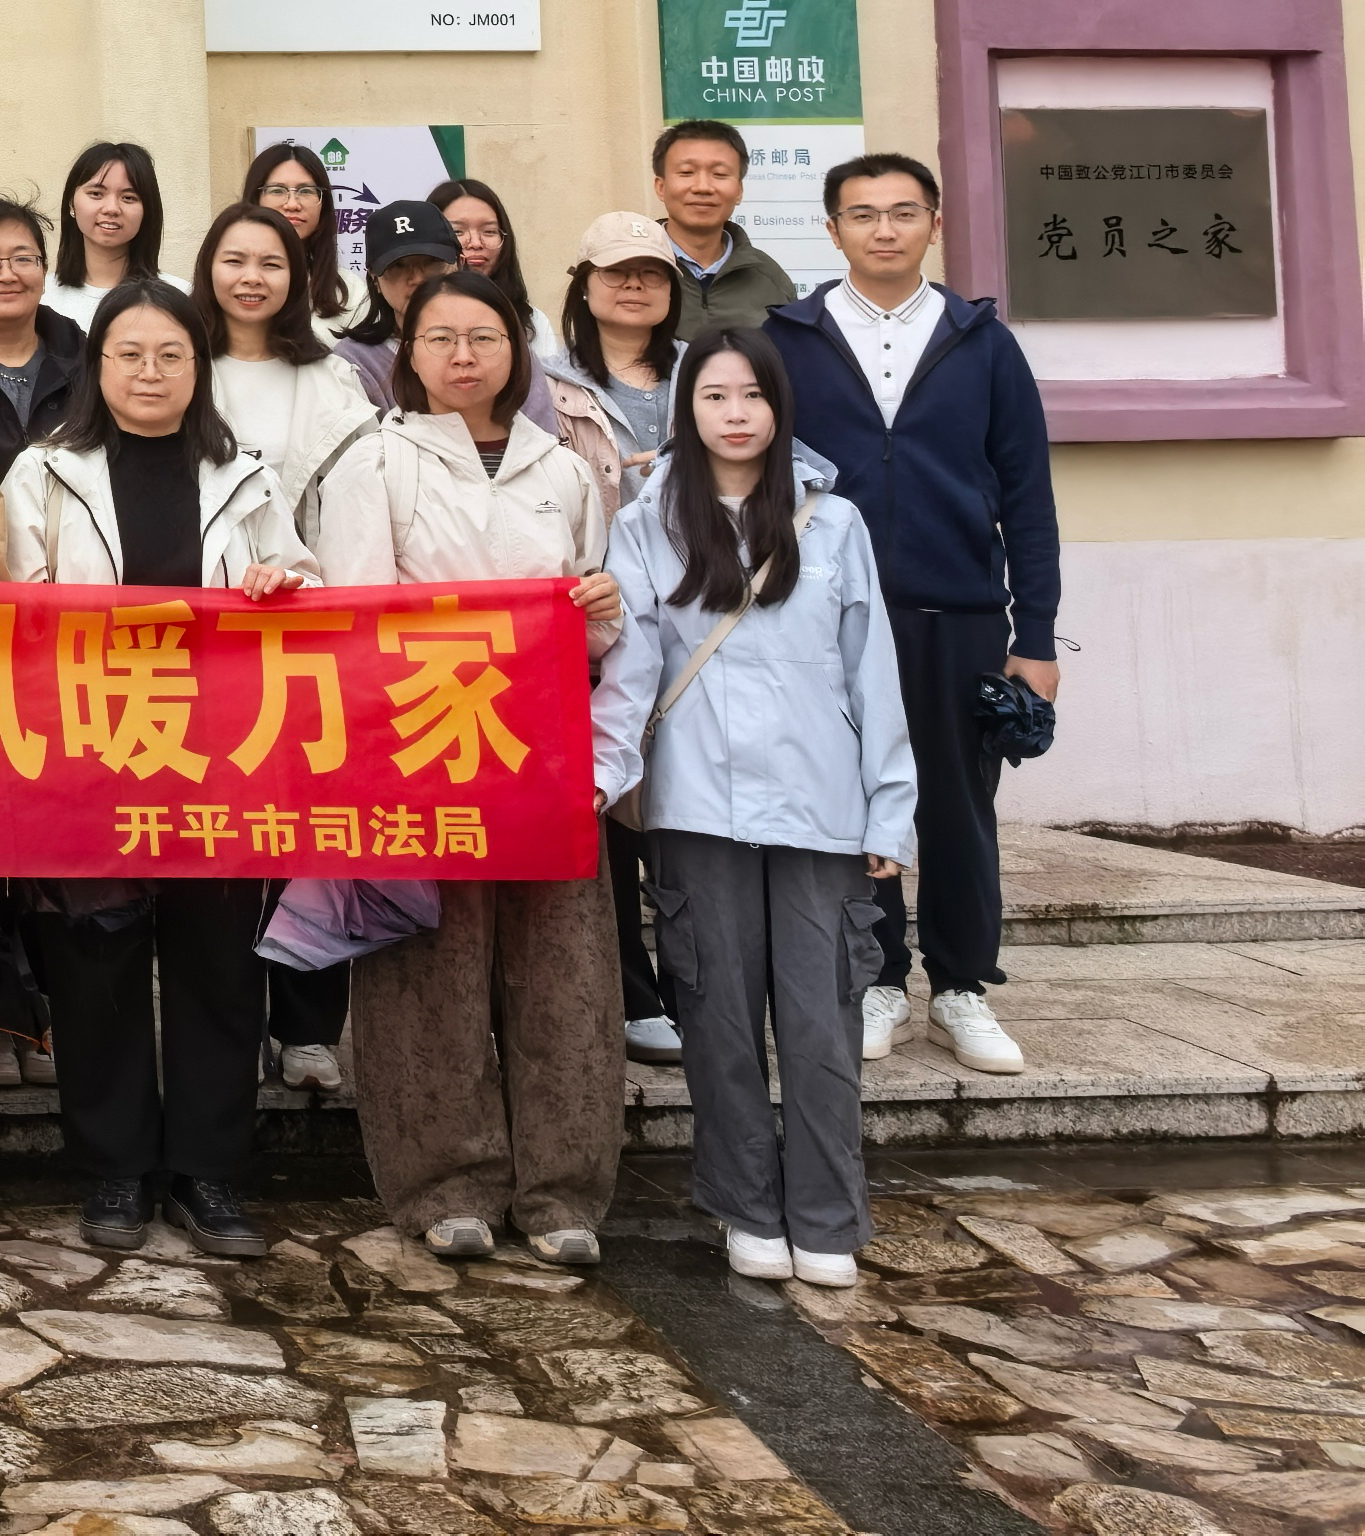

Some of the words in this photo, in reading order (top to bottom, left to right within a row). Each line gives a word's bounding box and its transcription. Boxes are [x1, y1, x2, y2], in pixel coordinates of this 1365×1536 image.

[469, 13, 516, 26] JM001
[701, 55, 826, 85] 中国邮政
[702, 88, 768, 103] CHINA
[776, 87, 826, 102] POST
[749, 148, 811, 166] 侨邮局
[1039, 163, 1234, 181] 中国致公党江门市委员会
[334, 208, 370, 235] 服务
[394, 216, 414, 235] R
[630, 221, 649, 238] R
[753, 215, 805, 226] Business
[1036, 211, 1245, 261] 党员之家
[113, 803, 489, 860] 开平市司法局
